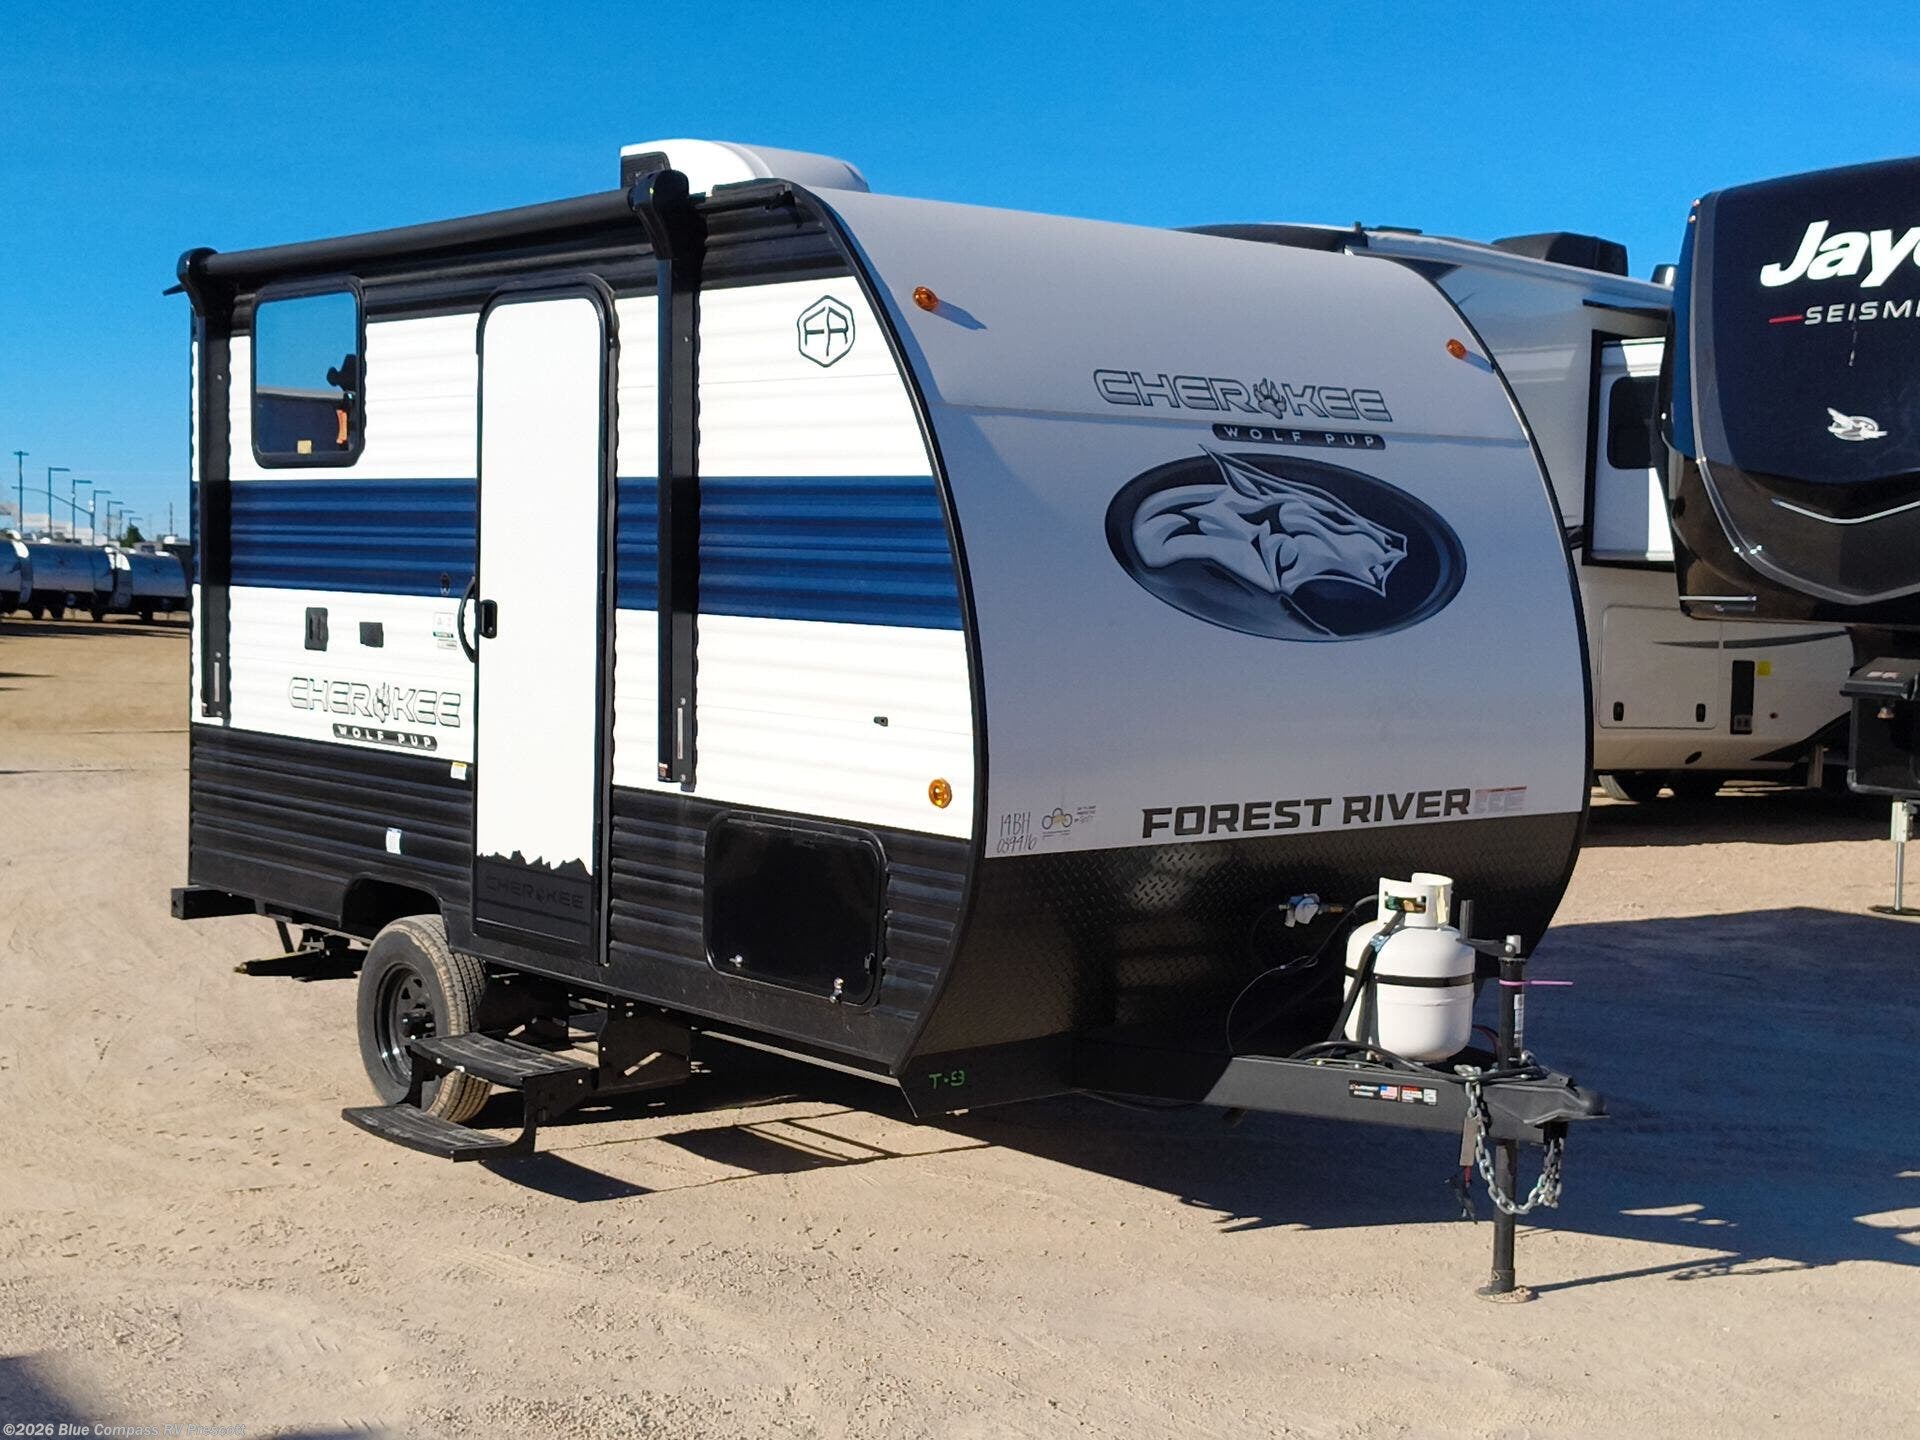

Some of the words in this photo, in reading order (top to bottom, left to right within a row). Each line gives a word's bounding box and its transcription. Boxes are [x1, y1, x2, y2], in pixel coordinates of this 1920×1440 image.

[1760, 220, 1920, 287] Jay
[1223, 425, 1302, 442] WOLF
[1325, 432, 1376, 448] PUP
[338, 726, 384, 741] WOLF
[397, 735, 432, 747] PUP
[1142, 797, 1332, 838] FOREST
[1342, 788, 1471, 824] RIVER
